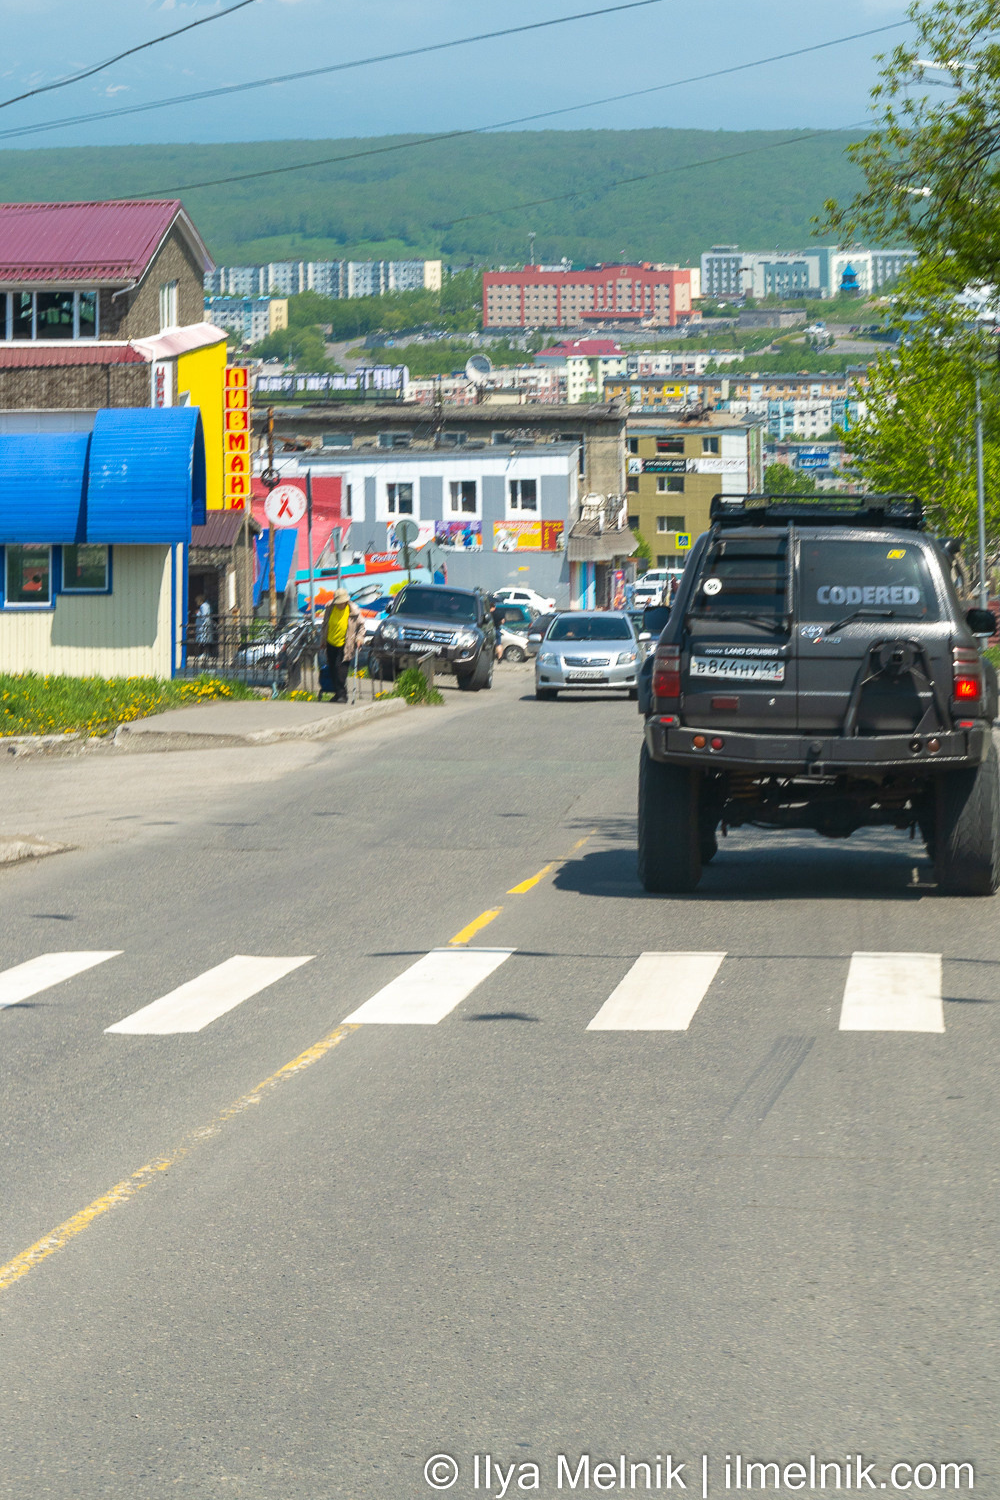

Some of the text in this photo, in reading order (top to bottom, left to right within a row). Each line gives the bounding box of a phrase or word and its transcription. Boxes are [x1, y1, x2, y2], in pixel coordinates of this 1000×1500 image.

[816, 585, 920, 605] CODERED
[724, 647, 746, 656] LAND
[746, 647, 779, 656] CRUISER
